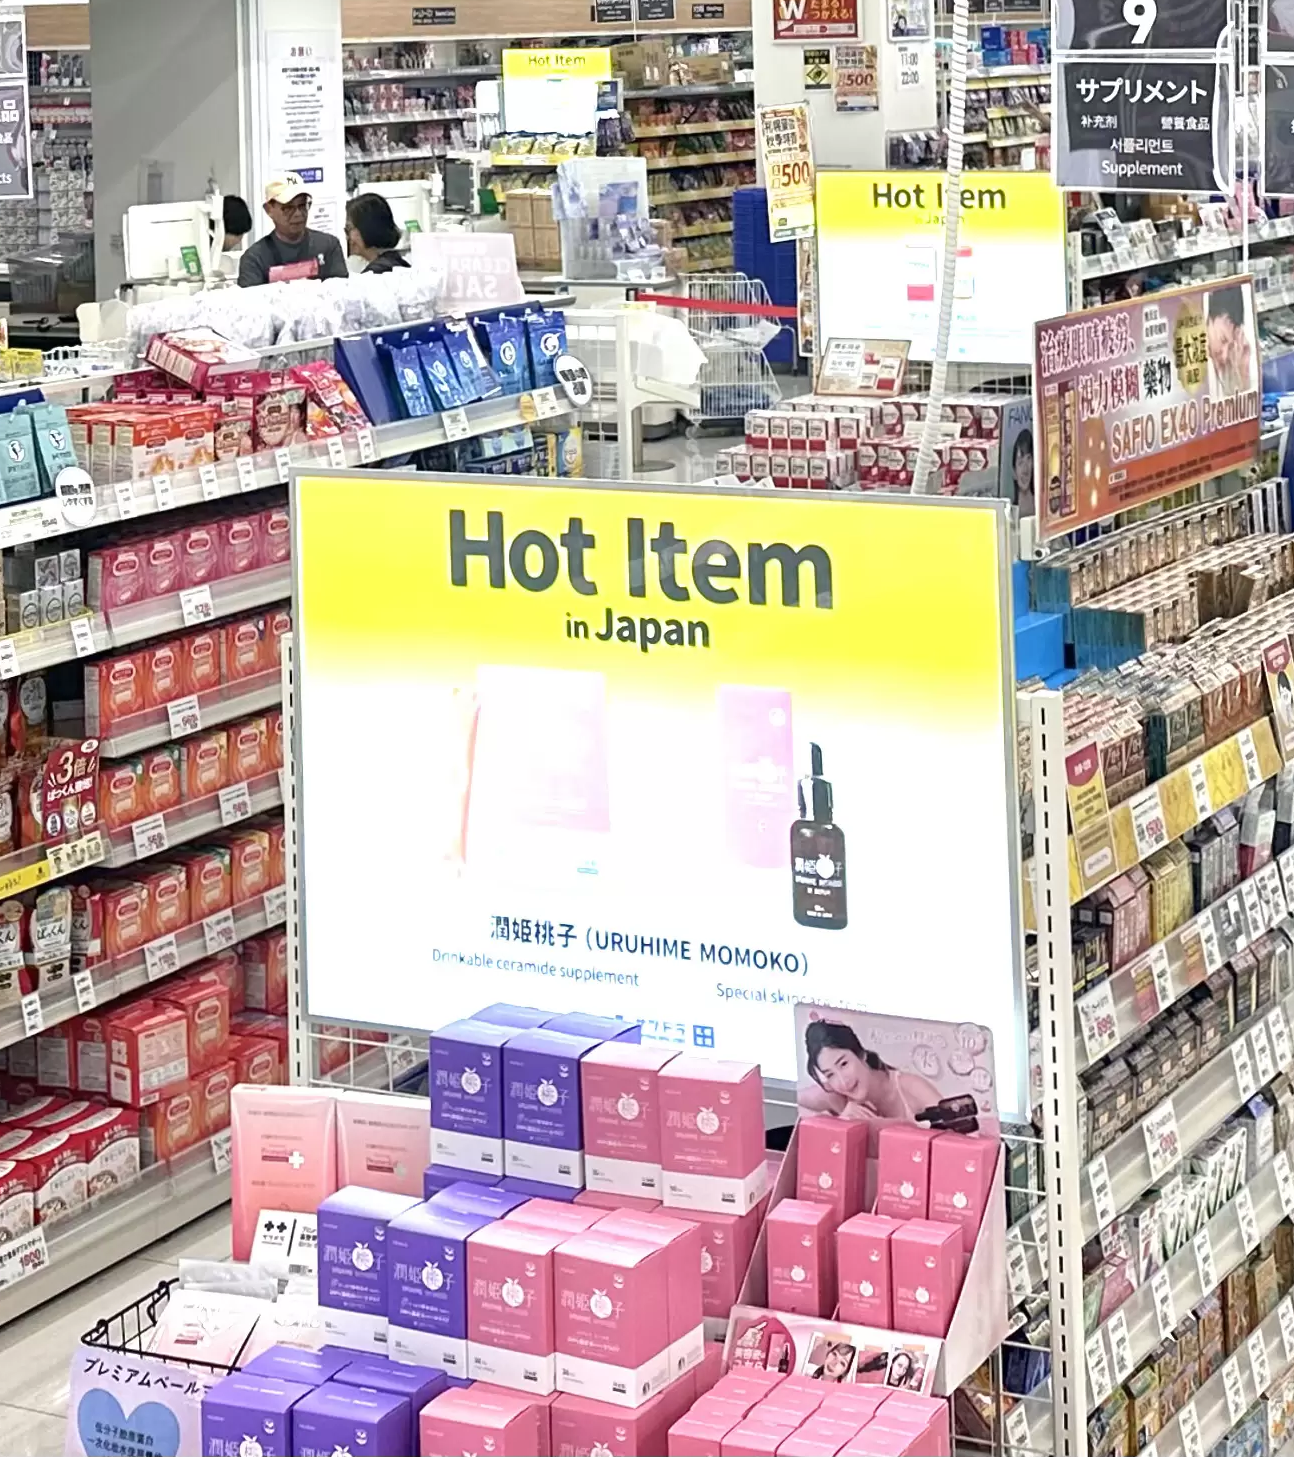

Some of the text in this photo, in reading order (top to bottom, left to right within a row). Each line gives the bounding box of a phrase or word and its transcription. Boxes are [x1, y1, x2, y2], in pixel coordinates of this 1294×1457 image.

[528, 55, 587, 67] Hot Item
[1076, 78, 1208, 105] サプリメント
[781, 161, 810, 188] 500
[1101, 159, 1184, 179] Supplement
[873, 180, 1007, 210] Hot Iem
[1160, 399, 1198, 443] EX40
[1201, 390, 1259, 435] Premium
[447, 507, 835, 613] Hot Item
[565, 607, 711, 654] in Japan
[585, 925, 693, 963] (URUHIME
[699, 942, 810, 978] MOMOKO)
[432, 947, 641, 988] Drinkable ceramide supplement
[716, 981, 768, 1004] Special
